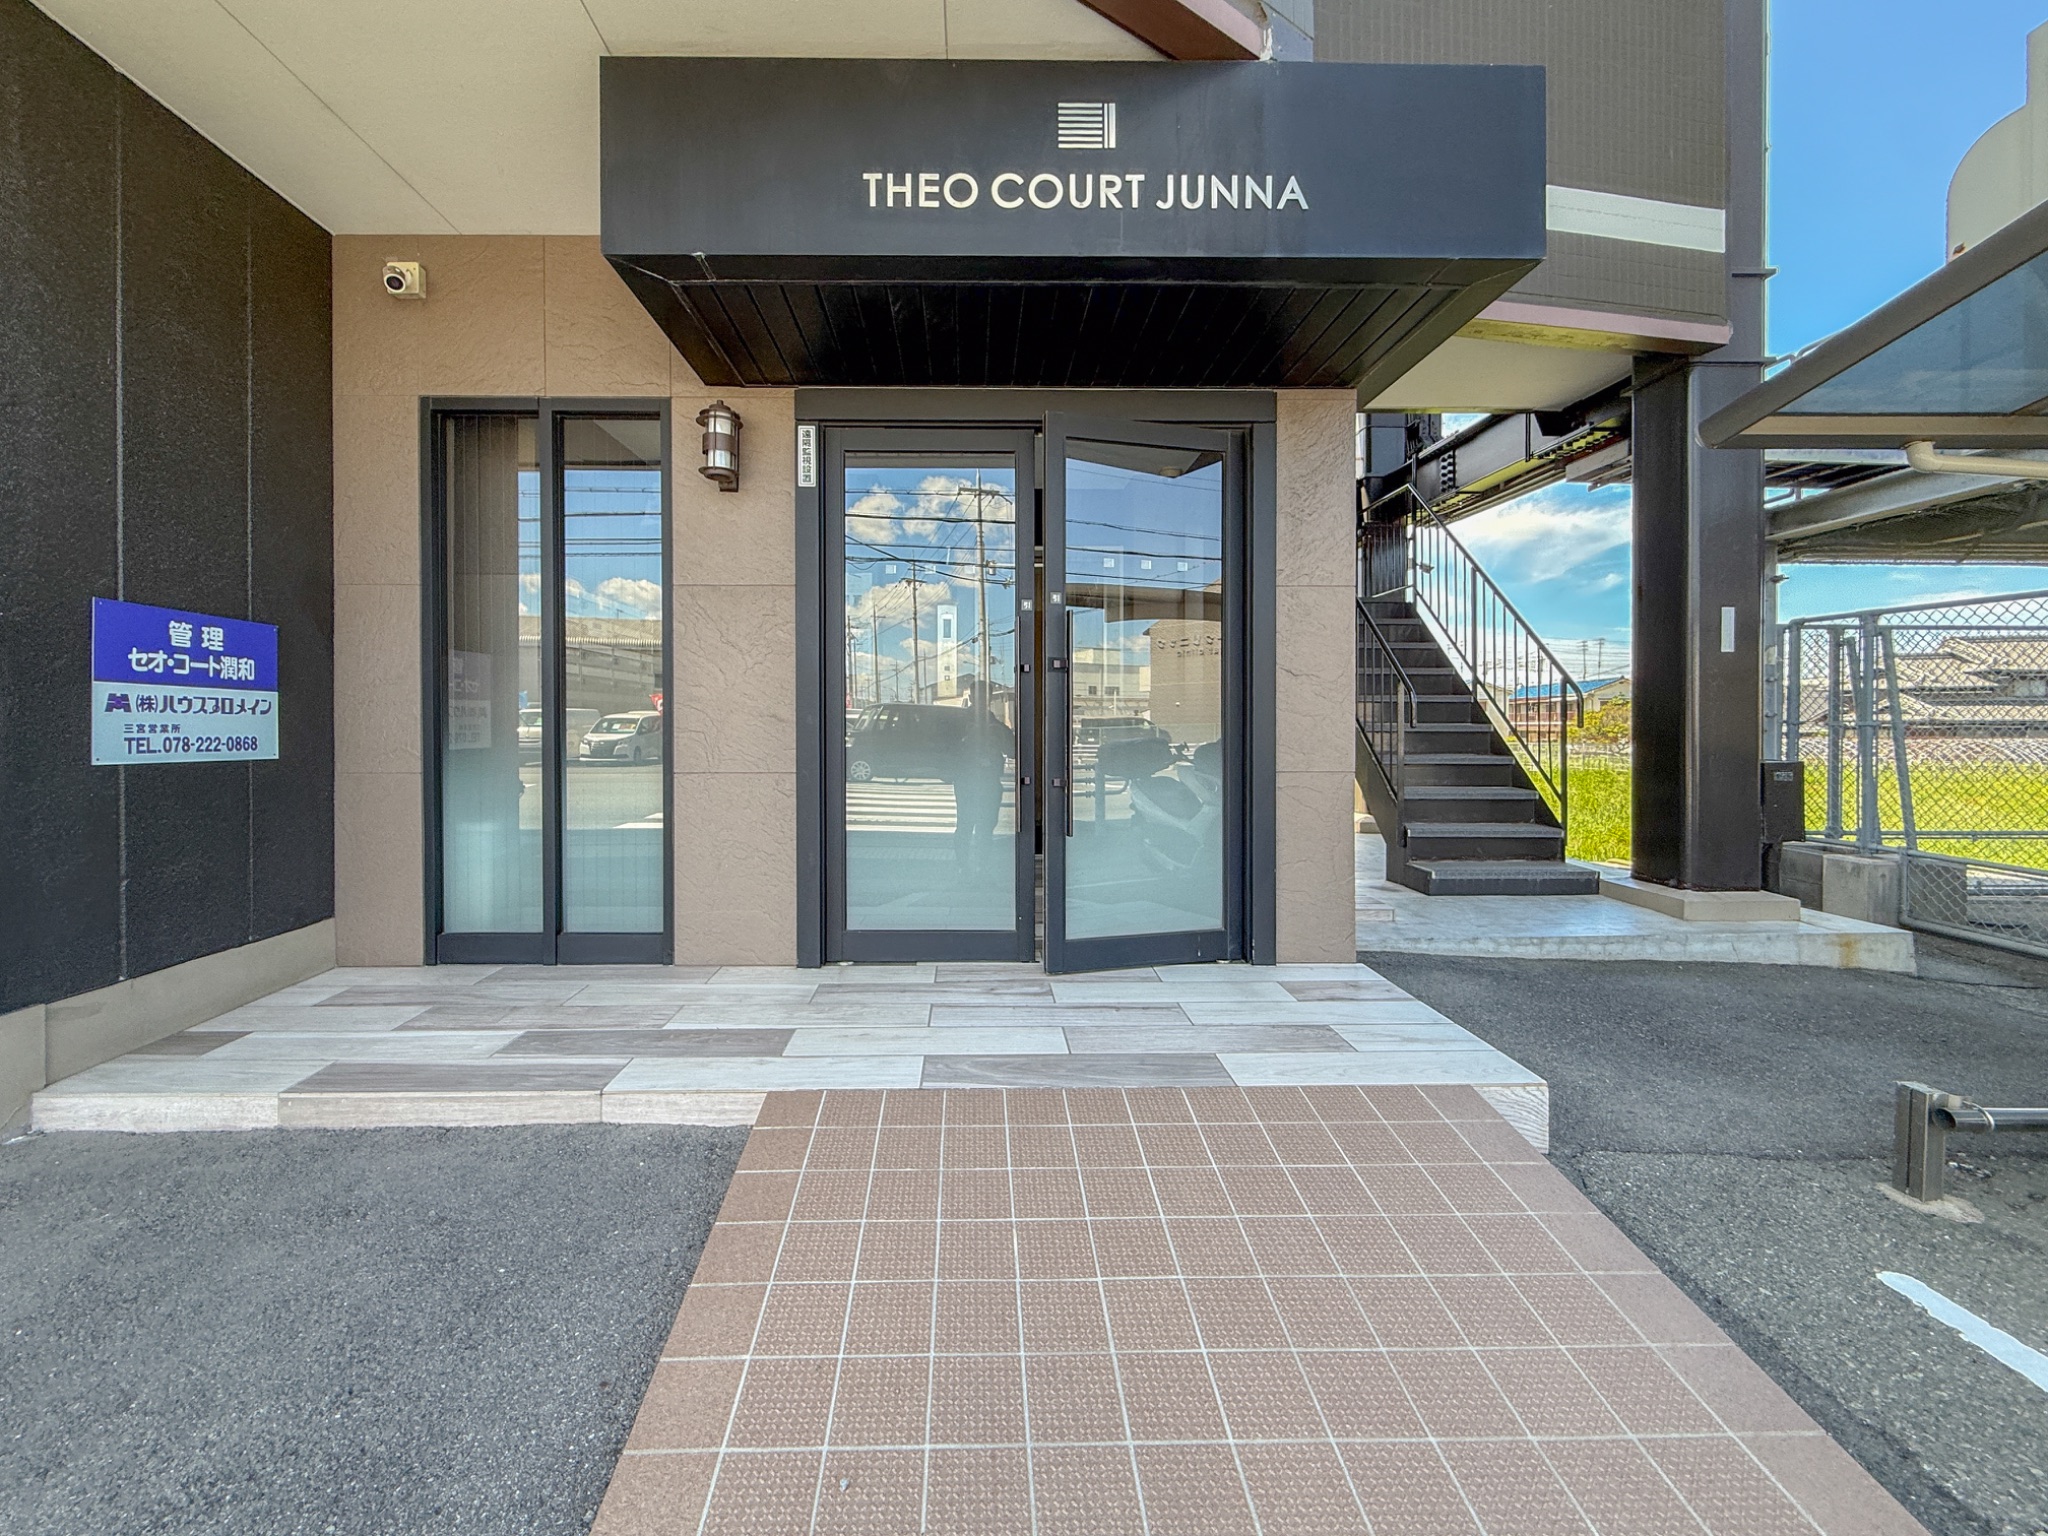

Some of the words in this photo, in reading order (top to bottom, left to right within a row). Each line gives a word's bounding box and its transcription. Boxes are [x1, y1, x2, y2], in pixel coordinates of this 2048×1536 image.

[862, 172, 979, 209] THEO
[990, 172, 1146, 209] COURT
[1155, 174, 1309, 210] JUNNA
[168, 620, 225, 651] 管理
[128, 647, 255, 681] セオ・コート潤和
[123, 723, 181, 734] 三宮営業所
[124, 736, 258, 755] TEL.078-222-0868
